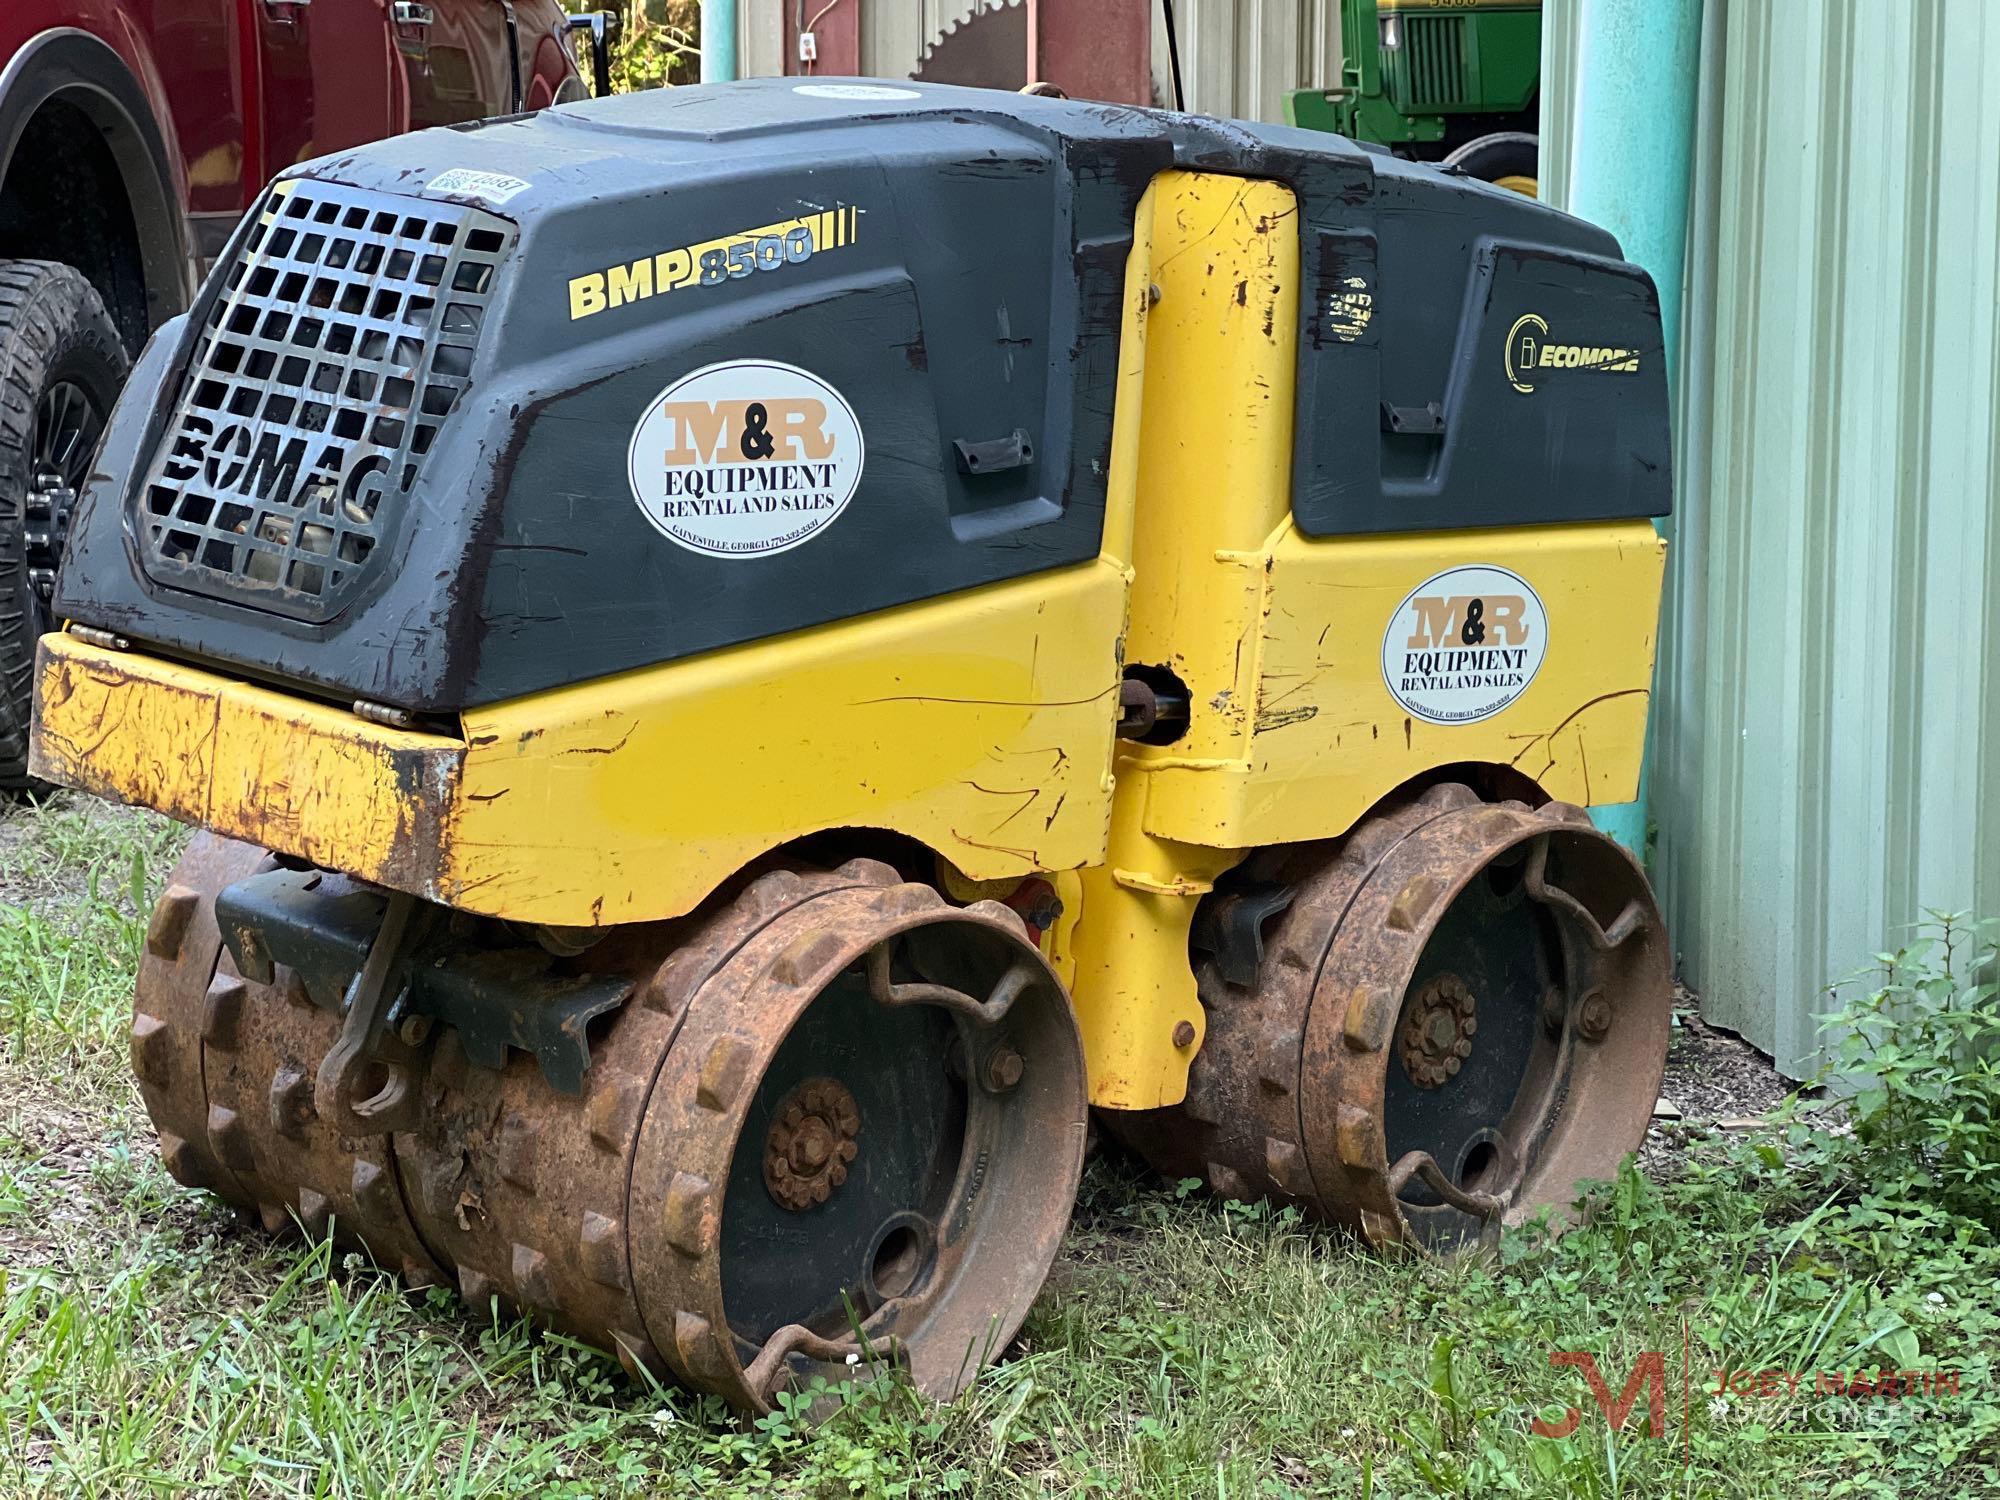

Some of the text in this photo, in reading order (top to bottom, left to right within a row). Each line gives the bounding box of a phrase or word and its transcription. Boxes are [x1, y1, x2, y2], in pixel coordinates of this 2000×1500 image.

[568, 225, 814, 321] BMP 8500
[664, 397, 836, 466] M&R
[162, 414, 391, 525] BOMAG
[663, 464, 837, 499] EQUIPMENT
[663, 493, 835, 518] RENTAL AND SALES
[731, 540, 770, 551] GEORGIA
[1407, 594, 1530, 649] M&R
[1403, 649, 1528, 676] EQUIPMENT
[1400, 673, 1524, 691] RENTAL AND SALES
[1445, 710, 1473, 719] GEORGIA
